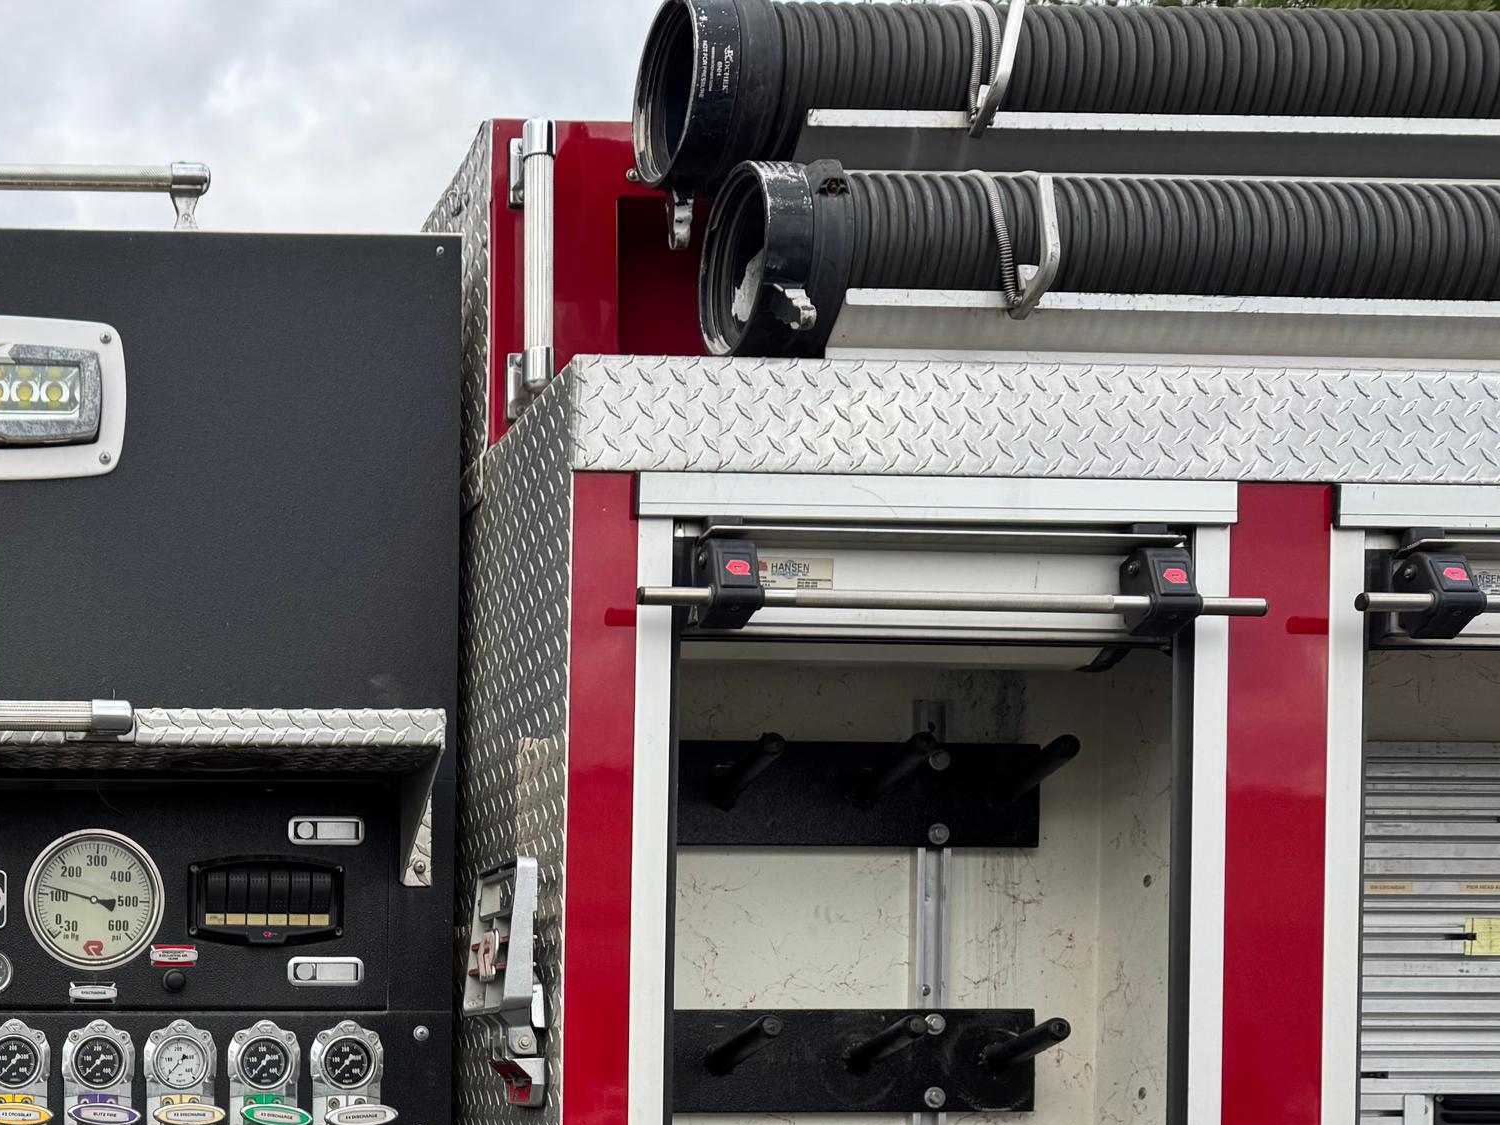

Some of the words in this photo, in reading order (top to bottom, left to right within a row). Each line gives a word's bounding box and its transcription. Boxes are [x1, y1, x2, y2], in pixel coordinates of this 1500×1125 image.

[771, 562, 810, 572] HANSEN
[86, 856, 107, 867] 300
[61, 866, 82, 878] 200
[110, 871, 131, 882] 400
[50, 891, 69, 902] 100
[118, 896, 138, 907] 500
[55, 914, 62, 925] 0
[60, 921, 78, 932] -30
[108, 920, 128, 932] 600
[112, 934, 122, 942] psi
